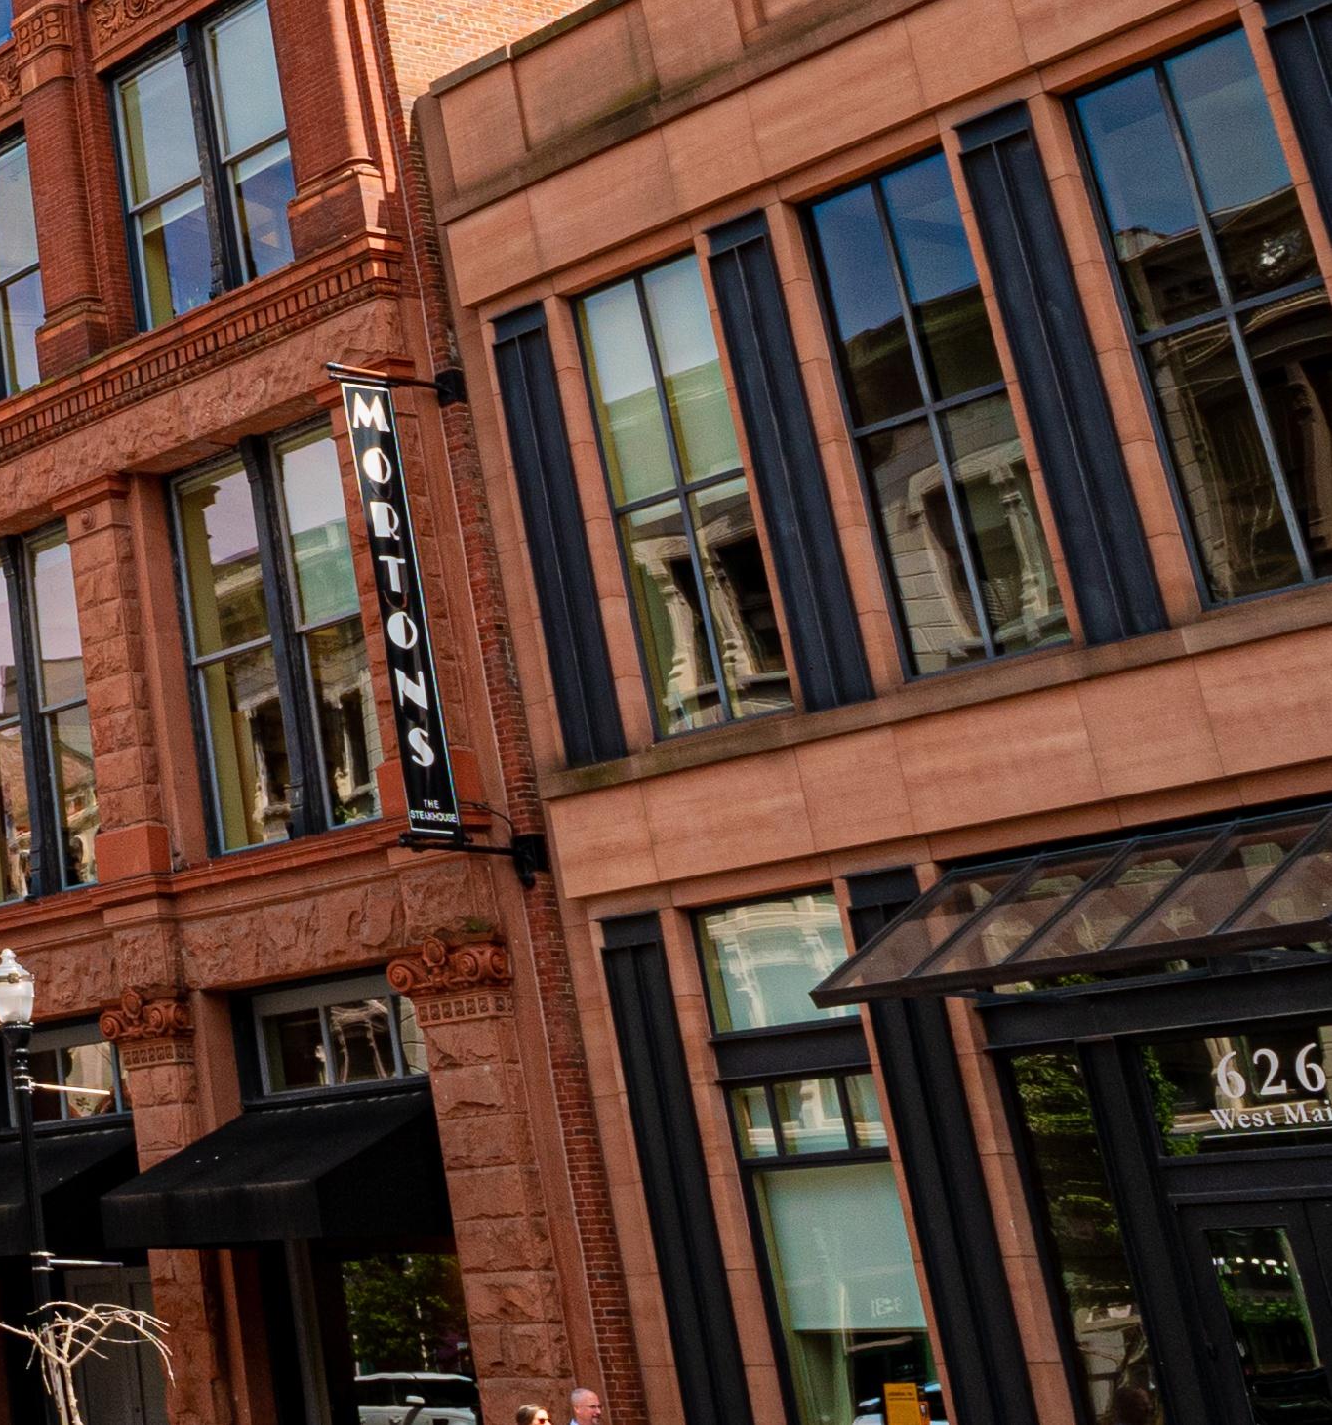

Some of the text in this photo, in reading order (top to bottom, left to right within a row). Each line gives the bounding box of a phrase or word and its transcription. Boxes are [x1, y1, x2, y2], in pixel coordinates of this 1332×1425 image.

[351, 391, 435, 767] MORTONS
[423, 799, 440, 810] THE
[1217, 1042, 1326, 1099] 626
[1210, 1107, 1276, 1130] West
